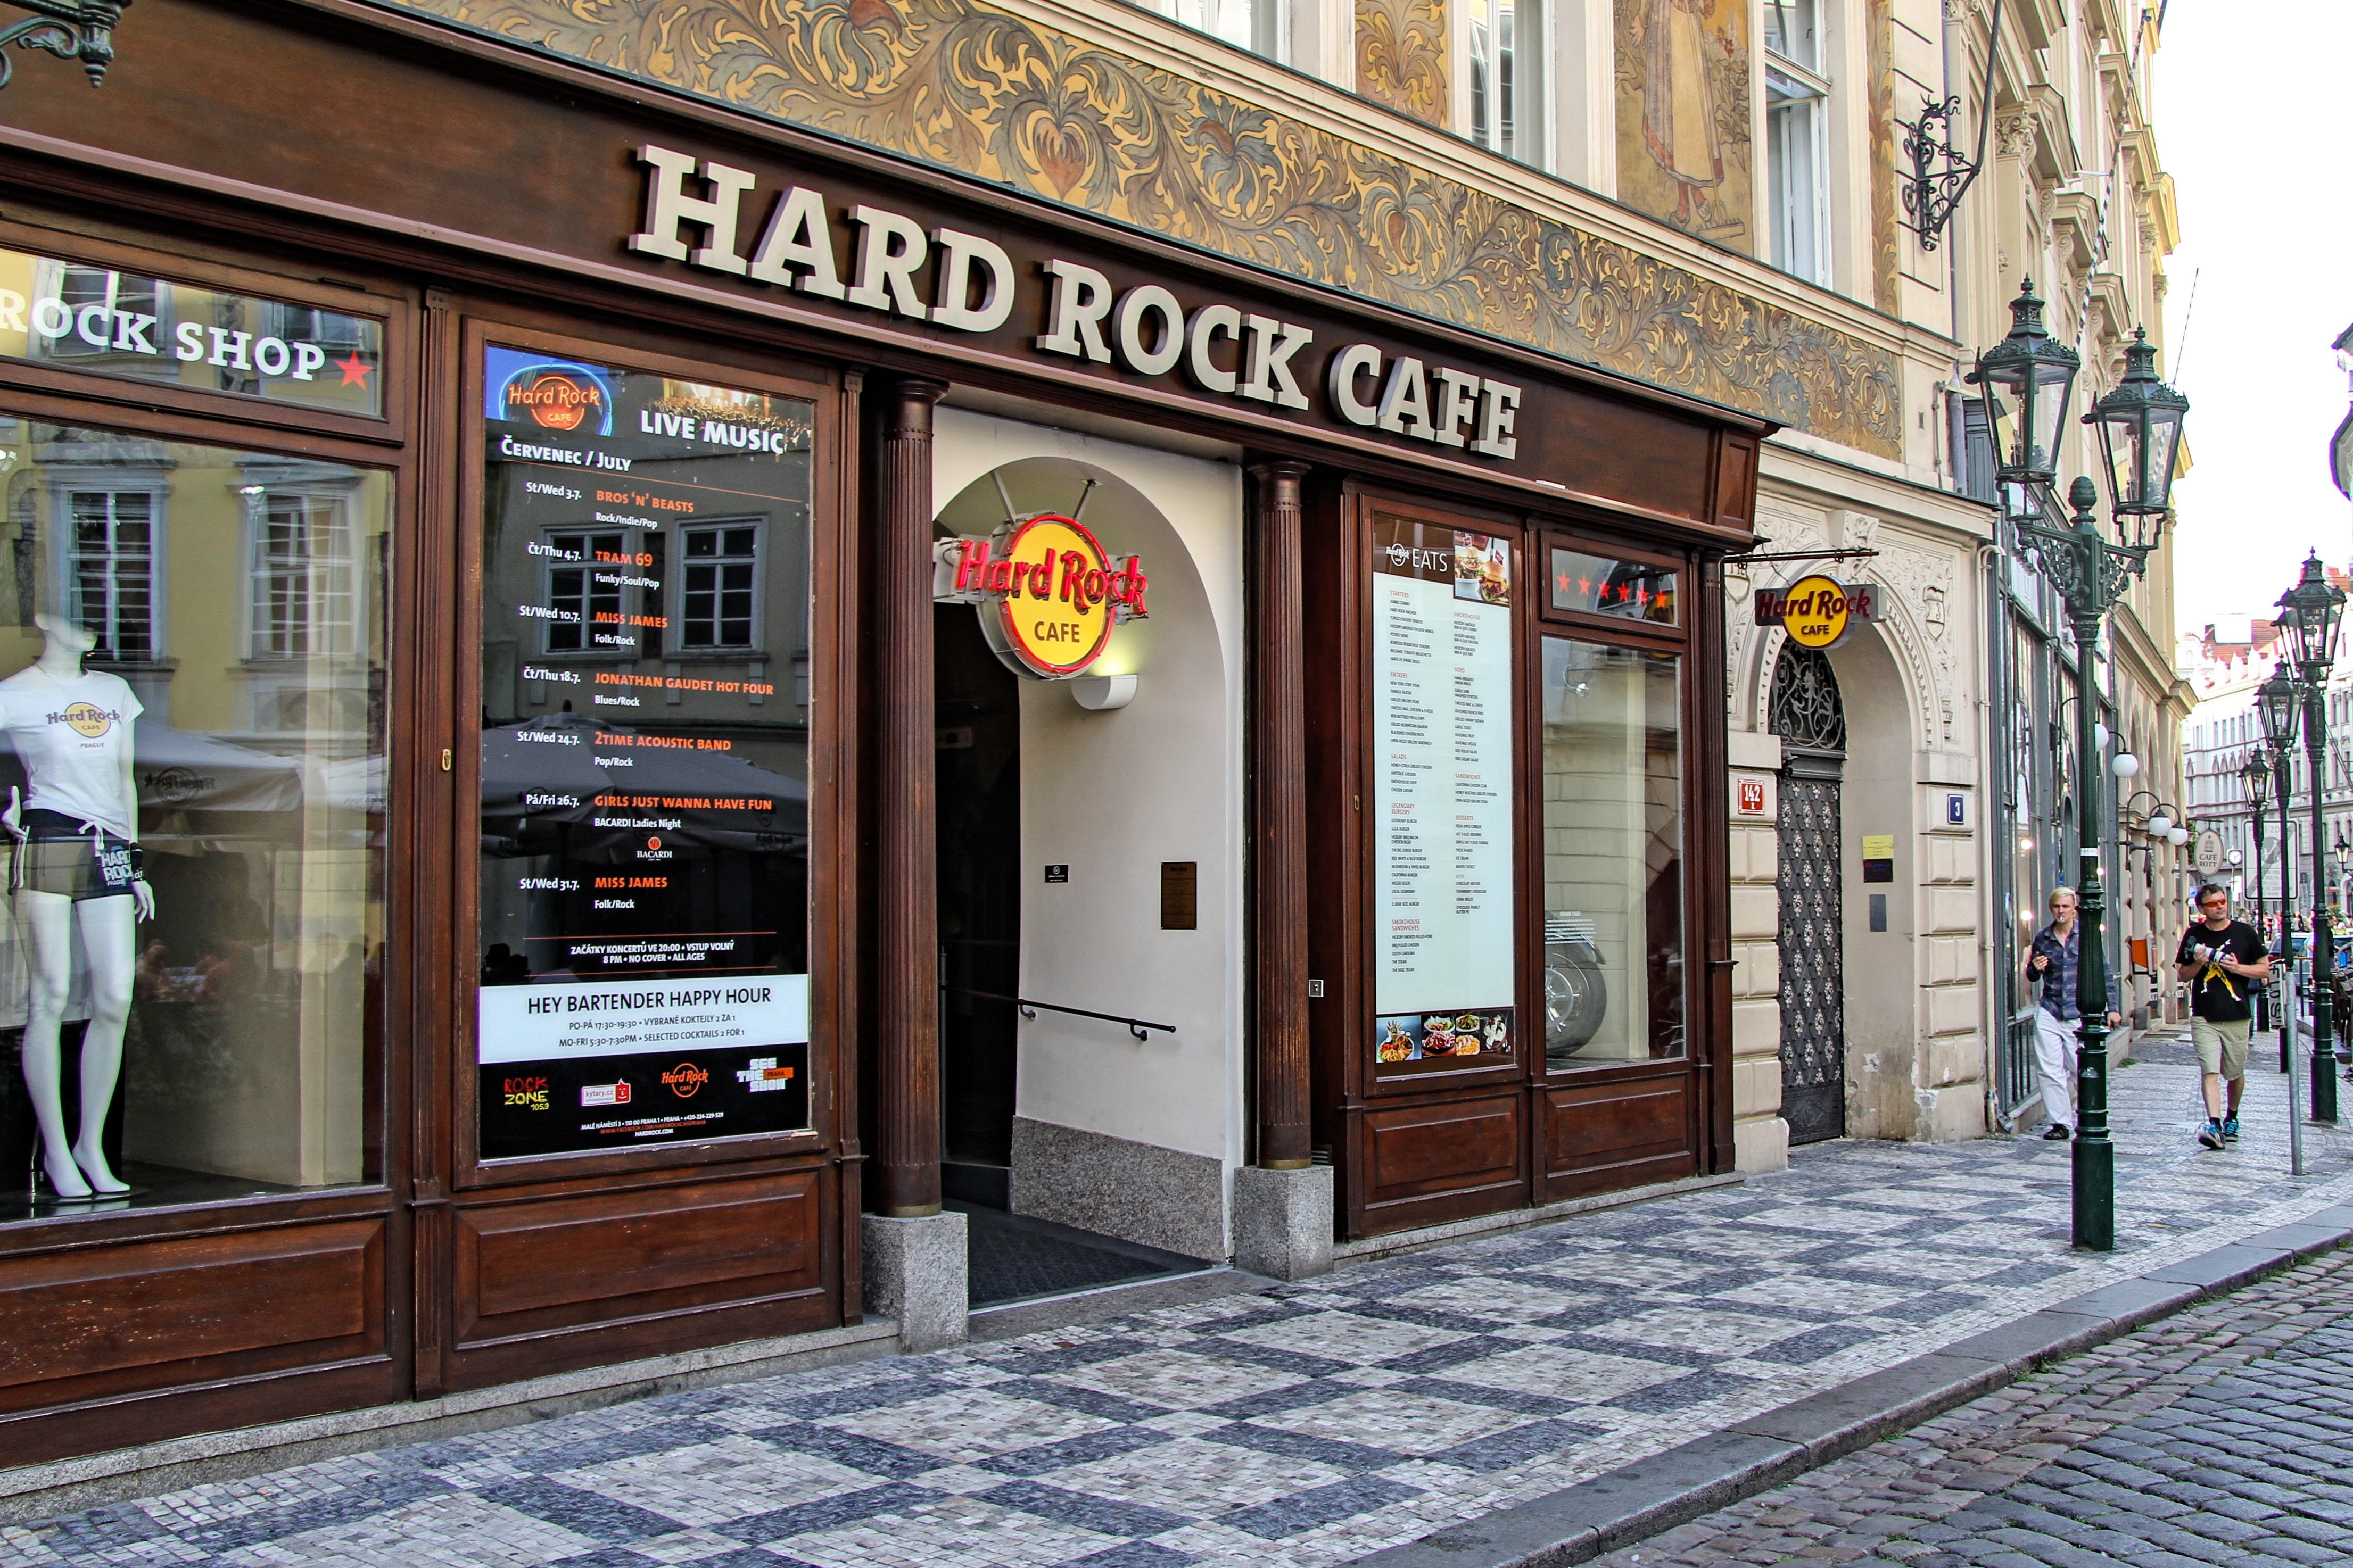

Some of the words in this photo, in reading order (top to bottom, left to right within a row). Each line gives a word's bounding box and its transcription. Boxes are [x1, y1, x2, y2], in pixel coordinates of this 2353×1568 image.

[629, 144, 1015, 333] HARD
[1036, 258, 1313, 411] ROCK
[1329, 343, 1521, 460] CAFE
[0, 288, 158, 355] ROCK
[175, 321, 326, 381] SHOP
[509, 384, 554, 404] Hard
[558, 385, 600, 408] Rock
[548, 413, 572, 422] CAFE
[640, 410, 695, 441] LIVE
[703, 420, 786, 455] MUSIC
[501, 434, 582, 465] ČERVENEC
[597, 452, 632, 471] JULY
[525, 481, 564, 496] St/Wed
[566, 489, 582, 501] 3.7.
[596, 490, 629, 505] BROS
[652, 497, 695, 513] BEASTS
[595, 511, 658, 530] Rock/Indie/Pop
[527, 541, 562, 558] Čt/Thu
[564, 550, 581, 561] 4.7.
[595, 551, 632, 565] TRAM
[634, 553, 653, 567] 69
[1412, 547, 1448, 573] EATS
[595, 573, 660, 591] Funky/Soul/Pop
[955, 539, 1055, 600] Hard
[1059, 550, 1148, 615] Rock
[1758, 590, 1815, 618] Hard
[1817, 588, 1871, 620] Rock
[519, 605, 558, 619] St/Wed
[559, 611, 581, 623] 10.7.
[595, 612, 626, 624] MISS
[628, 615, 668, 628] JAMES
[1454, 611, 1481, 620] SMOKEHOUSE
[1034, 620, 1080, 643] CAFE
[1801, 625, 1830, 635] CAFE
[595, 634, 635, 646] Folk/Rock
[523, 666, 558, 681] Čt/Thu
[559, 672, 581, 684] 18.7.
[595, 673, 663, 687] JONATHAN
[665, 677, 713, 691] GAUDET
[716, 681, 740, 692] HOT
[742, 683, 773, 695] FOUR
[594, 694, 640, 707] Blues/Rock
[46, 709, 85, 725] Hard
[86, 709, 122, 725] Rock
[517, 731, 556, 743] St/Wed
[557, 735, 580, 746] 24.7.
[595, 731, 633, 746] 2TIME
[636, 736, 694, 749] ACOUSTIC
[697, 739, 732, 751] BAND
[594, 756, 633, 768] Pop/Rock
[526, 793, 555, 806] Pá/Fri
[557, 795, 580, 808] 26.7.
[1745, 784, 1760, 802] 142
[594, 795, 629, 807] GIRLS
[632, 797, 659, 808] JUST
[662, 797, 711, 809] WANNA
[714, 799, 745, 809] HAVE
[748, 799, 772, 810] FUN
[1955, 802, 1960, 817] 3
[594, 817, 631, 827] BACARDI
[632, 818, 657, 828] Ladies
[658, 819, 681, 830] Night
[101, 850, 130, 868] HARD
[519, 877, 557, 889] St/Wed
[559, 879, 580, 891] 31.7.
[595, 877, 625, 888] MISS
[628, 877, 668, 888] JAMES
[594, 899, 635, 909] Folk/Rock
[571, 944, 606, 955] ZAČÁTKY
[606, 941, 647, 953] KONCERTŮ
[658, 943, 681, 952] 20:00
[686, 942, 709, 951] VSTUP
[709, 939, 734, 950] VOLNÝ
[642, 953, 666, 962] COVER
[686, 952, 705, 961] AGES
[527, 996, 563, 1014] HEY
[567, 991, 664, 1011] BARTENDER
[670, 989, 722, 1007] HAPPY
[726, 987, 772, 1004] HOUR
[569, 1019, 593, 1030] PO-PÁ
[595, 1019, 637, 1031] 17:30-19:30
[643, 1015, 679, 1026] VYBRANÉ
[680, 1015, 715, 1024] KOKTEJLY
[559, 1038, 588, 1047] MO-FRI
[589, 1035, 637, 1048] 5:30-7:30PM
[643, 1032, 679, 1042] SELECTED
[680, 1030, 719, 1040] COCKTAILS
[749, 1057, 777, 1070] SEE
[662, 1071, 686, 1084] Hard
[686, 1069, 708, 1084] Rock
[736, 1070, 764, 1082] THE
[503, 1076, 549, 1093] ROCK
[749, 1078, 788, 1092] SHOW
[504, 1090, 549, 1105] ZONE
[585, 1089, 614, 1098] kytary.cz
[634, 1128, 674, 1137] HARDROCK.COM
